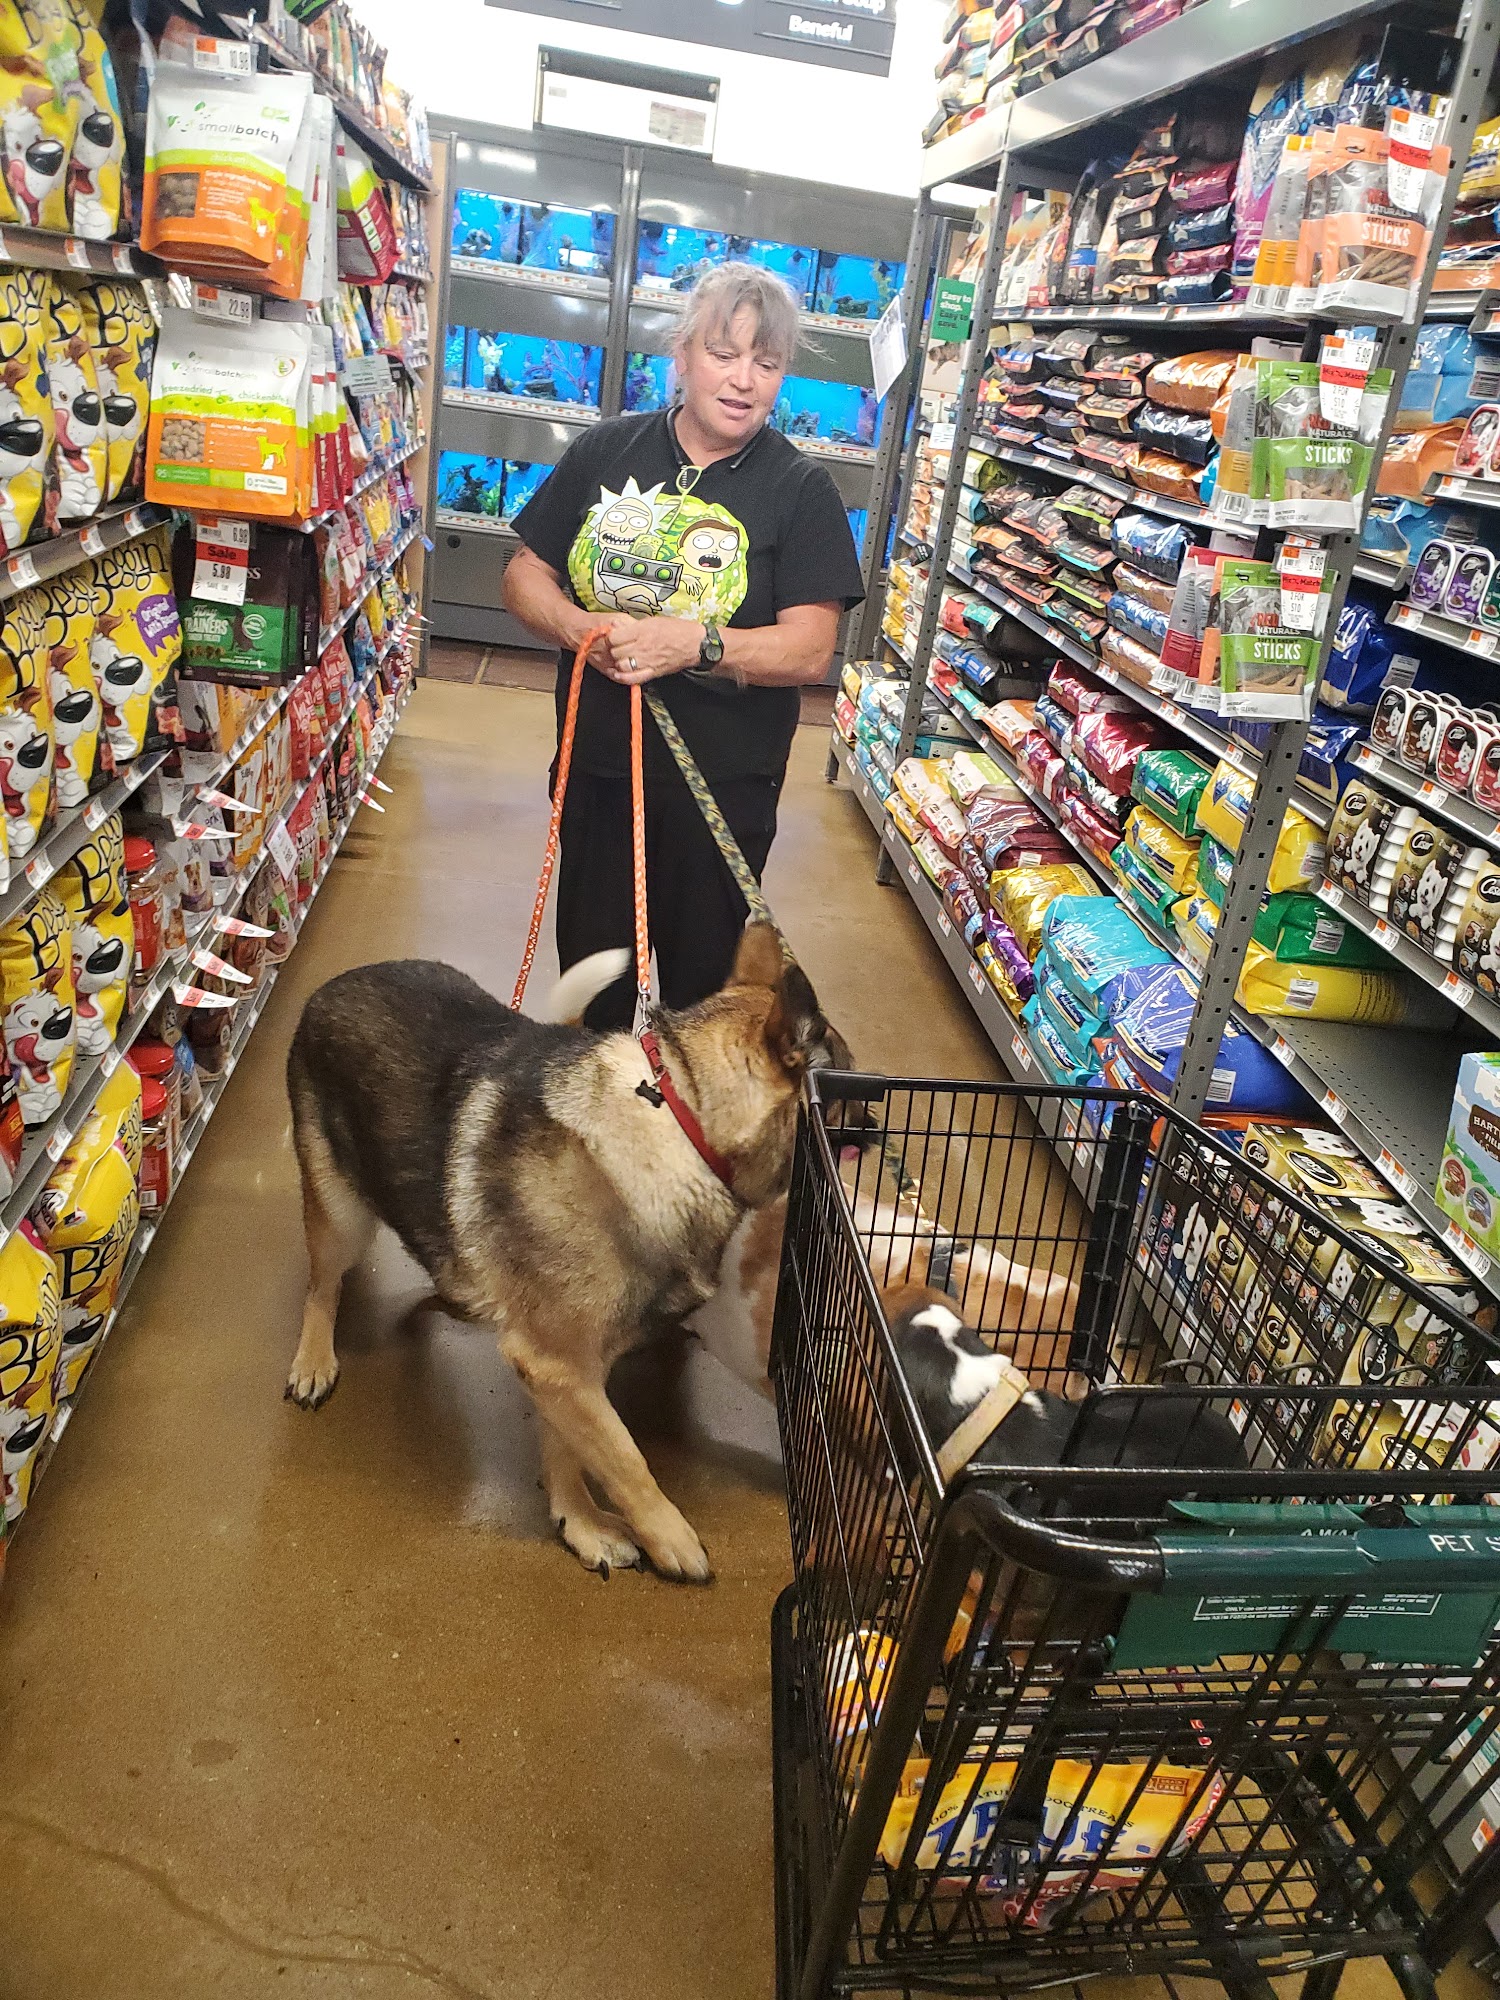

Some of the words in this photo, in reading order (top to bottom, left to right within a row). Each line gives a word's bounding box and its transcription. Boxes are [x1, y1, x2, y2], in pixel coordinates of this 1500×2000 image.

[788, 14, 854, 42] Beneful
[199, 121, 280, 144] smallbatch
[1361, 221, 1412, 247] STICKS
[940, 300, 963, 312] shop.
[941, 291, 963, 304] Easy
[962, 294, 972, 303] to
[938, 320, 958, 329] save.
[940, 309, 959, 321] Easy
[1308, 429, 1353, 439] NATURALS
[1305, 445, 1353, 465] STICKS
[208, 545, 238, 561] Sale
[184, 616, 229, 636] TRAINERS
[1256, 626, 1301, 636] NATURALS
[1253, 641, 1302, 661] STICKS
[1246, 1142, 1269, 1165] Cesar
[1428, 1534, 1473, 1553] PET
[1078, 1805, 1135, 1828] TREAS
